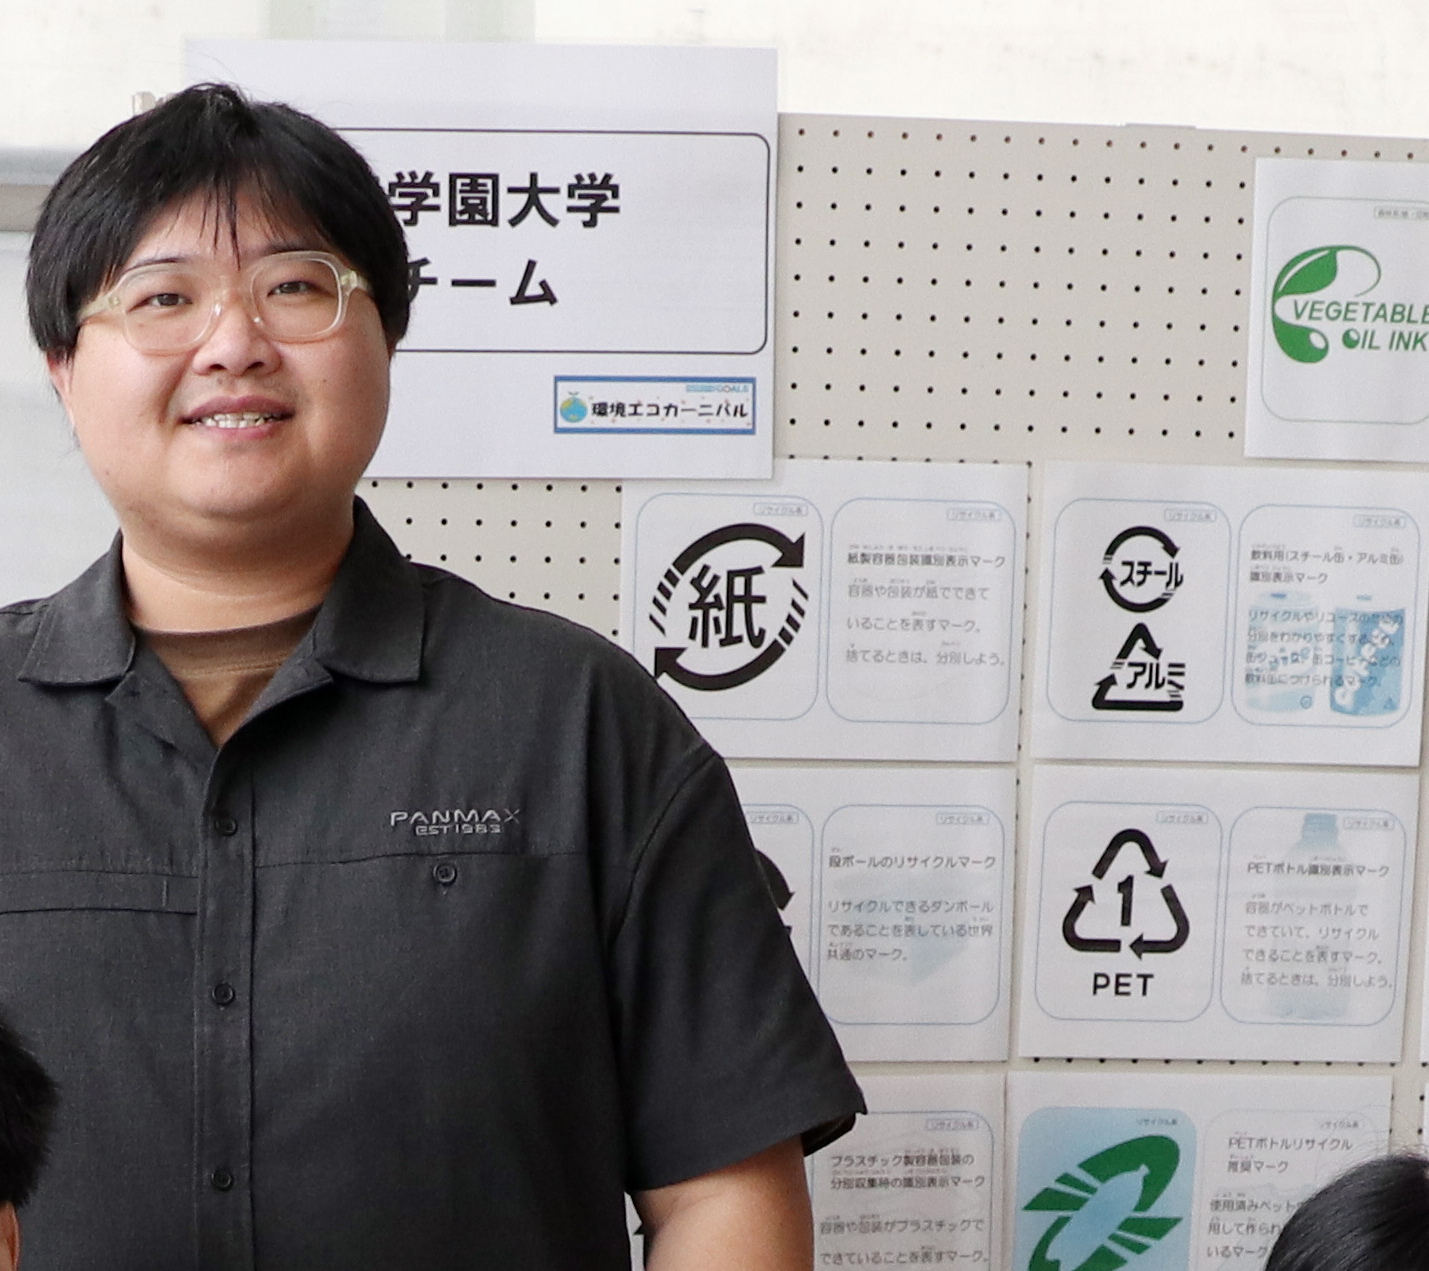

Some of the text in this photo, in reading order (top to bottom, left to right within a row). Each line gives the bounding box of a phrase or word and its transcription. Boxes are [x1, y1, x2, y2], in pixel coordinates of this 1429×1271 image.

[1341, 328, 1429, 352] OIL INK
[591, 401, 748, 418] 環境エコカーニバル
[1119, 560, 1184, 589] スチール
[688, 563, 767, 649] 紙
[1126, 661, 1186, 690] アルミ
[391, 808, 521, 827] PANMAX
[828, 855, 996, 870] 段ボールのリサイクルマーク
[1117, 875, 1135, 927] 1
[1092, 973, 1155, 997] PET
[1210, 1199, 1303, 1213] 使用済みペット
